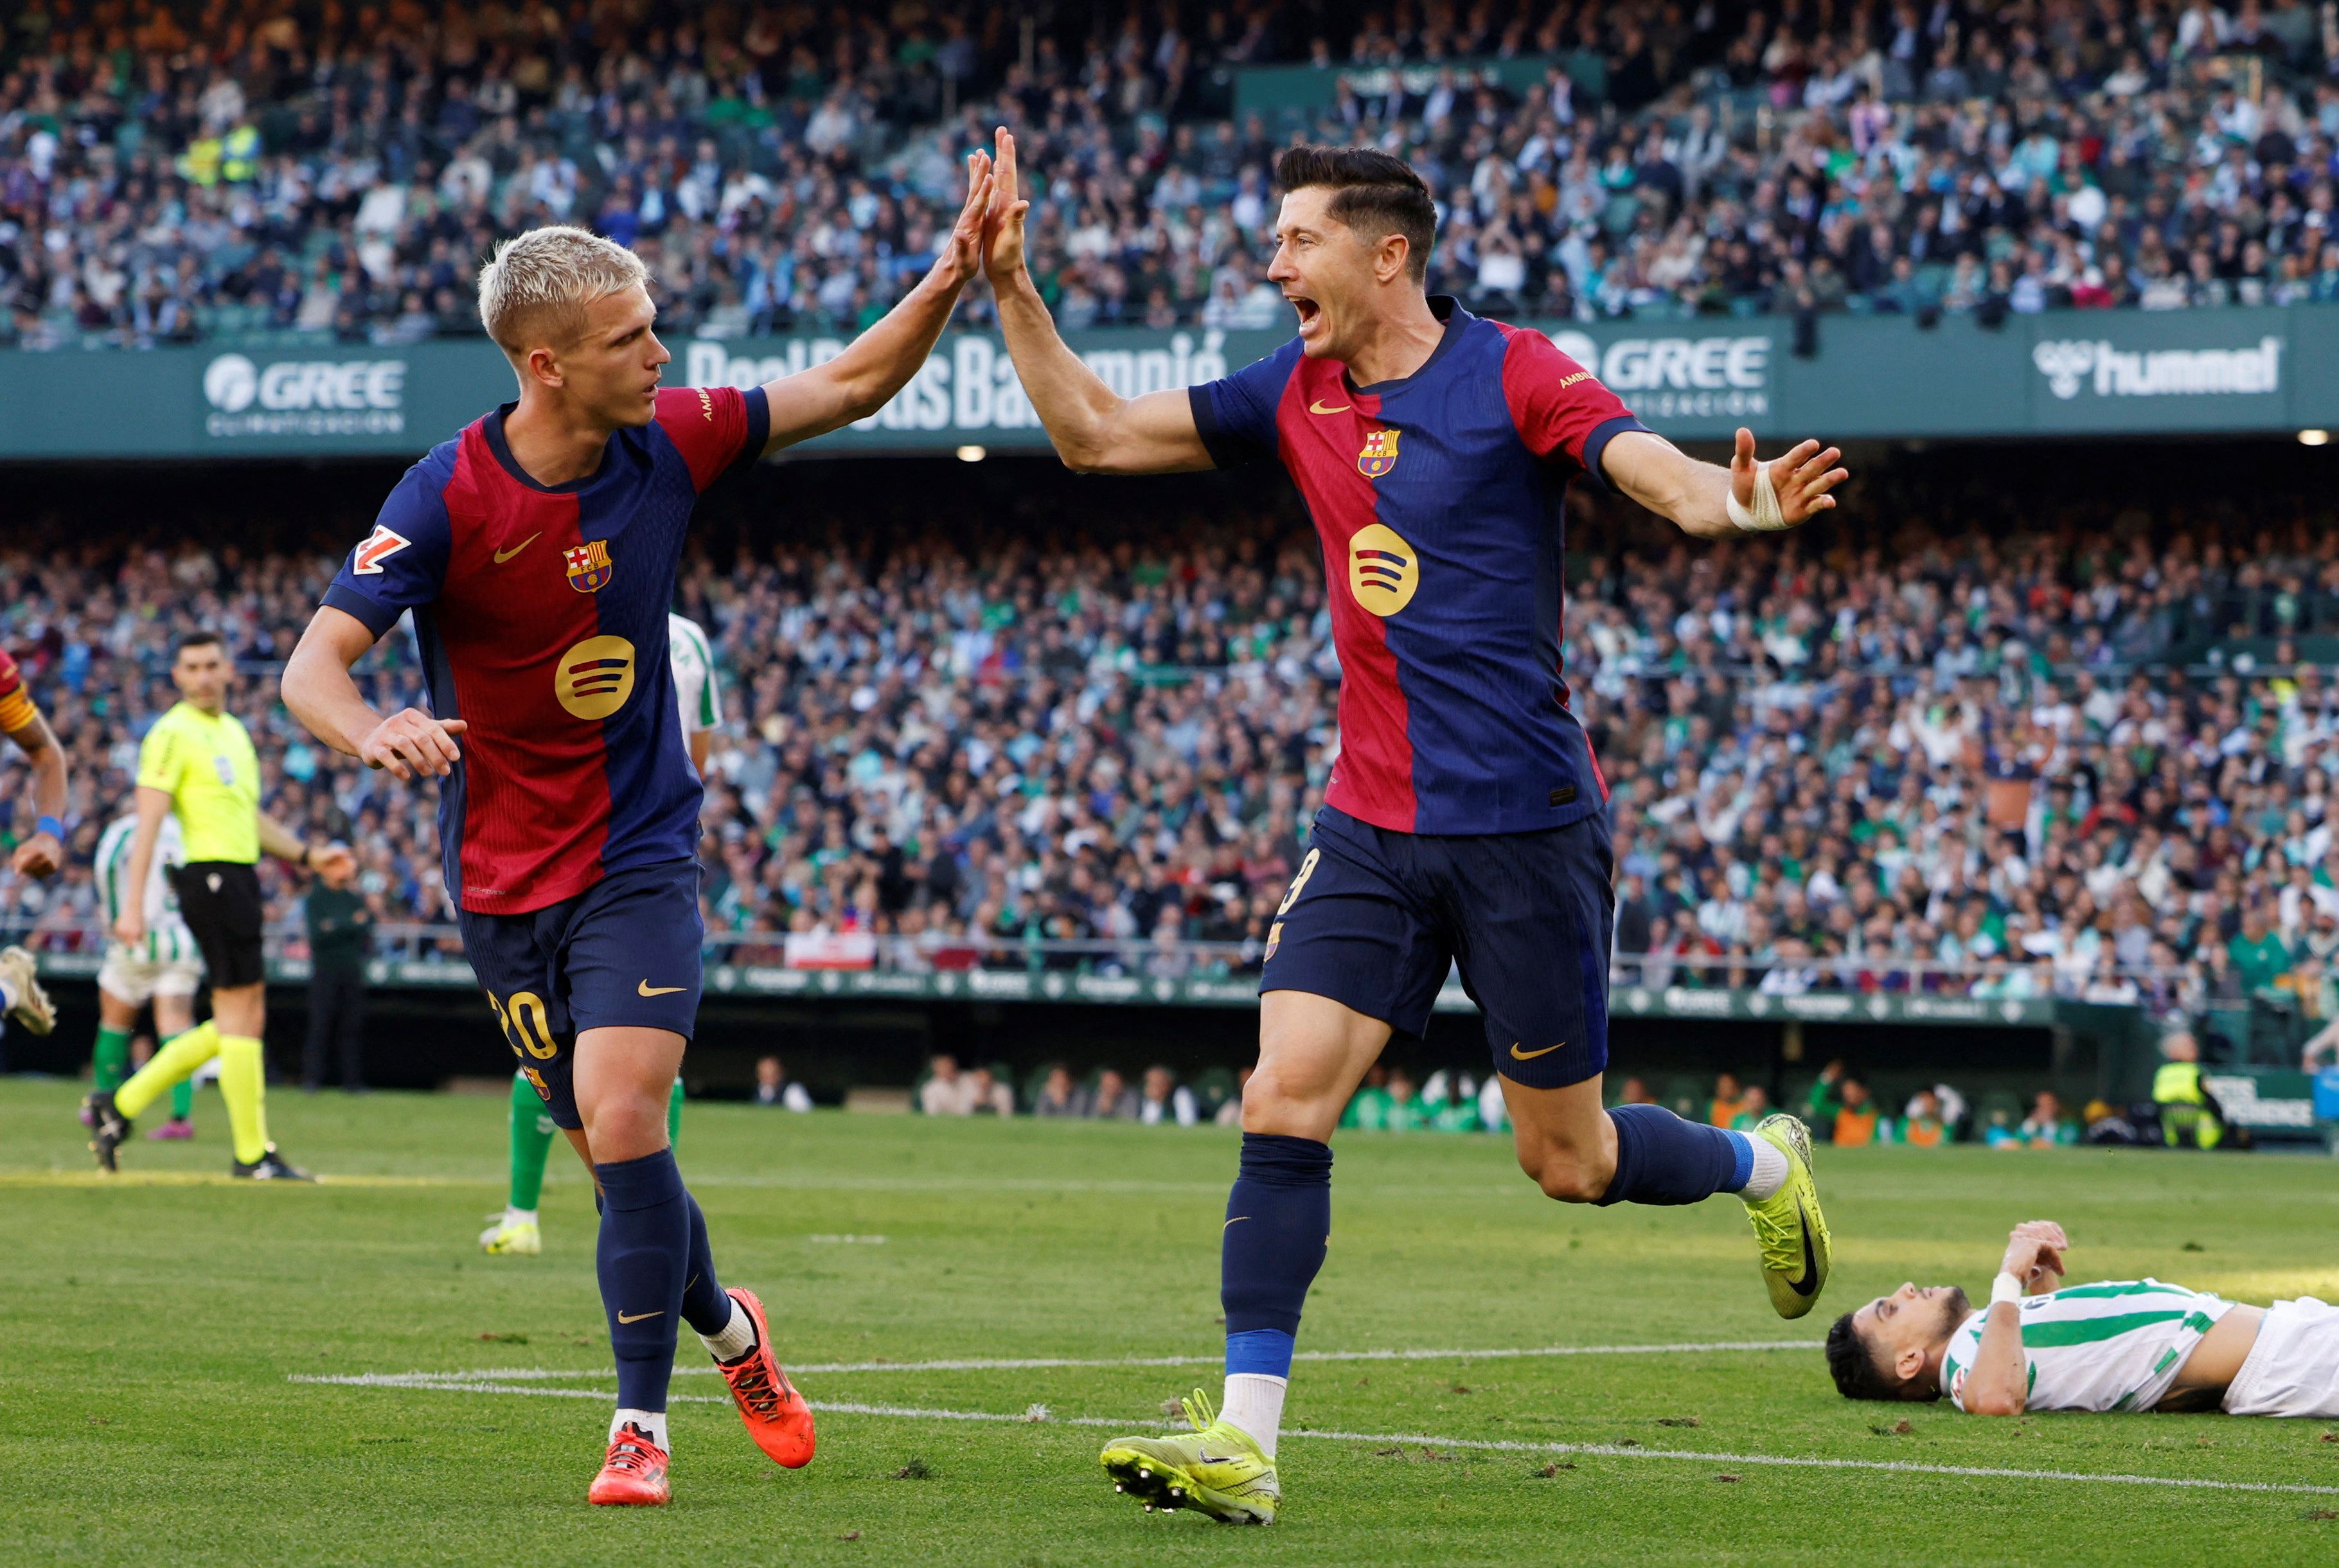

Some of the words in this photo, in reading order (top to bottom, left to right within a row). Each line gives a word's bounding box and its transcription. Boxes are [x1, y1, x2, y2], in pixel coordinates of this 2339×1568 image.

[258, 360, 407, 410] GREE
[1603, 336, 1772, 389] GREE
[1277, 848, 1321, 916] 9
[487, 989, 557, 1060] 20
